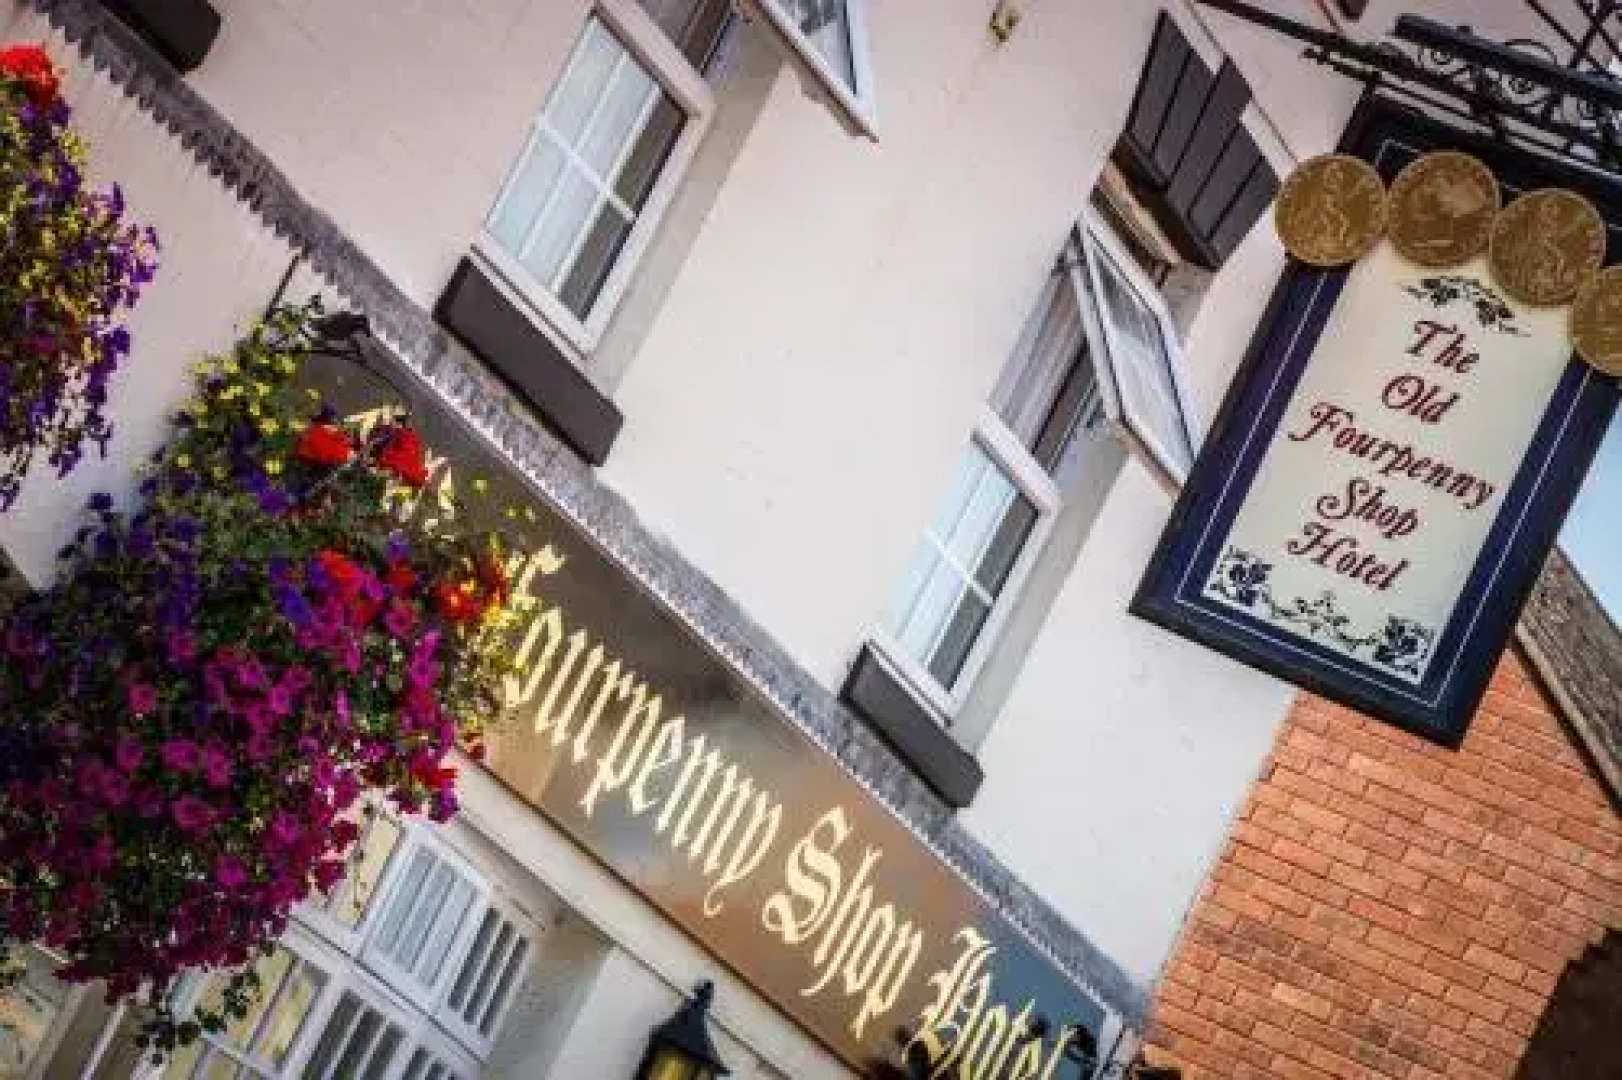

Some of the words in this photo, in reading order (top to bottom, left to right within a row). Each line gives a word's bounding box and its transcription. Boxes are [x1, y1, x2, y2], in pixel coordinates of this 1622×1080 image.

[1406, 320, 1480, 374] The
[1381, 374, 1461, 423] Old
[1288, 402, 1496, 509] Fourpenny
[1316, 477, 1419, 539] Shop
[1287, 521, 1409, 590] Hotel
[762, 806, 923, 1040] Shop
